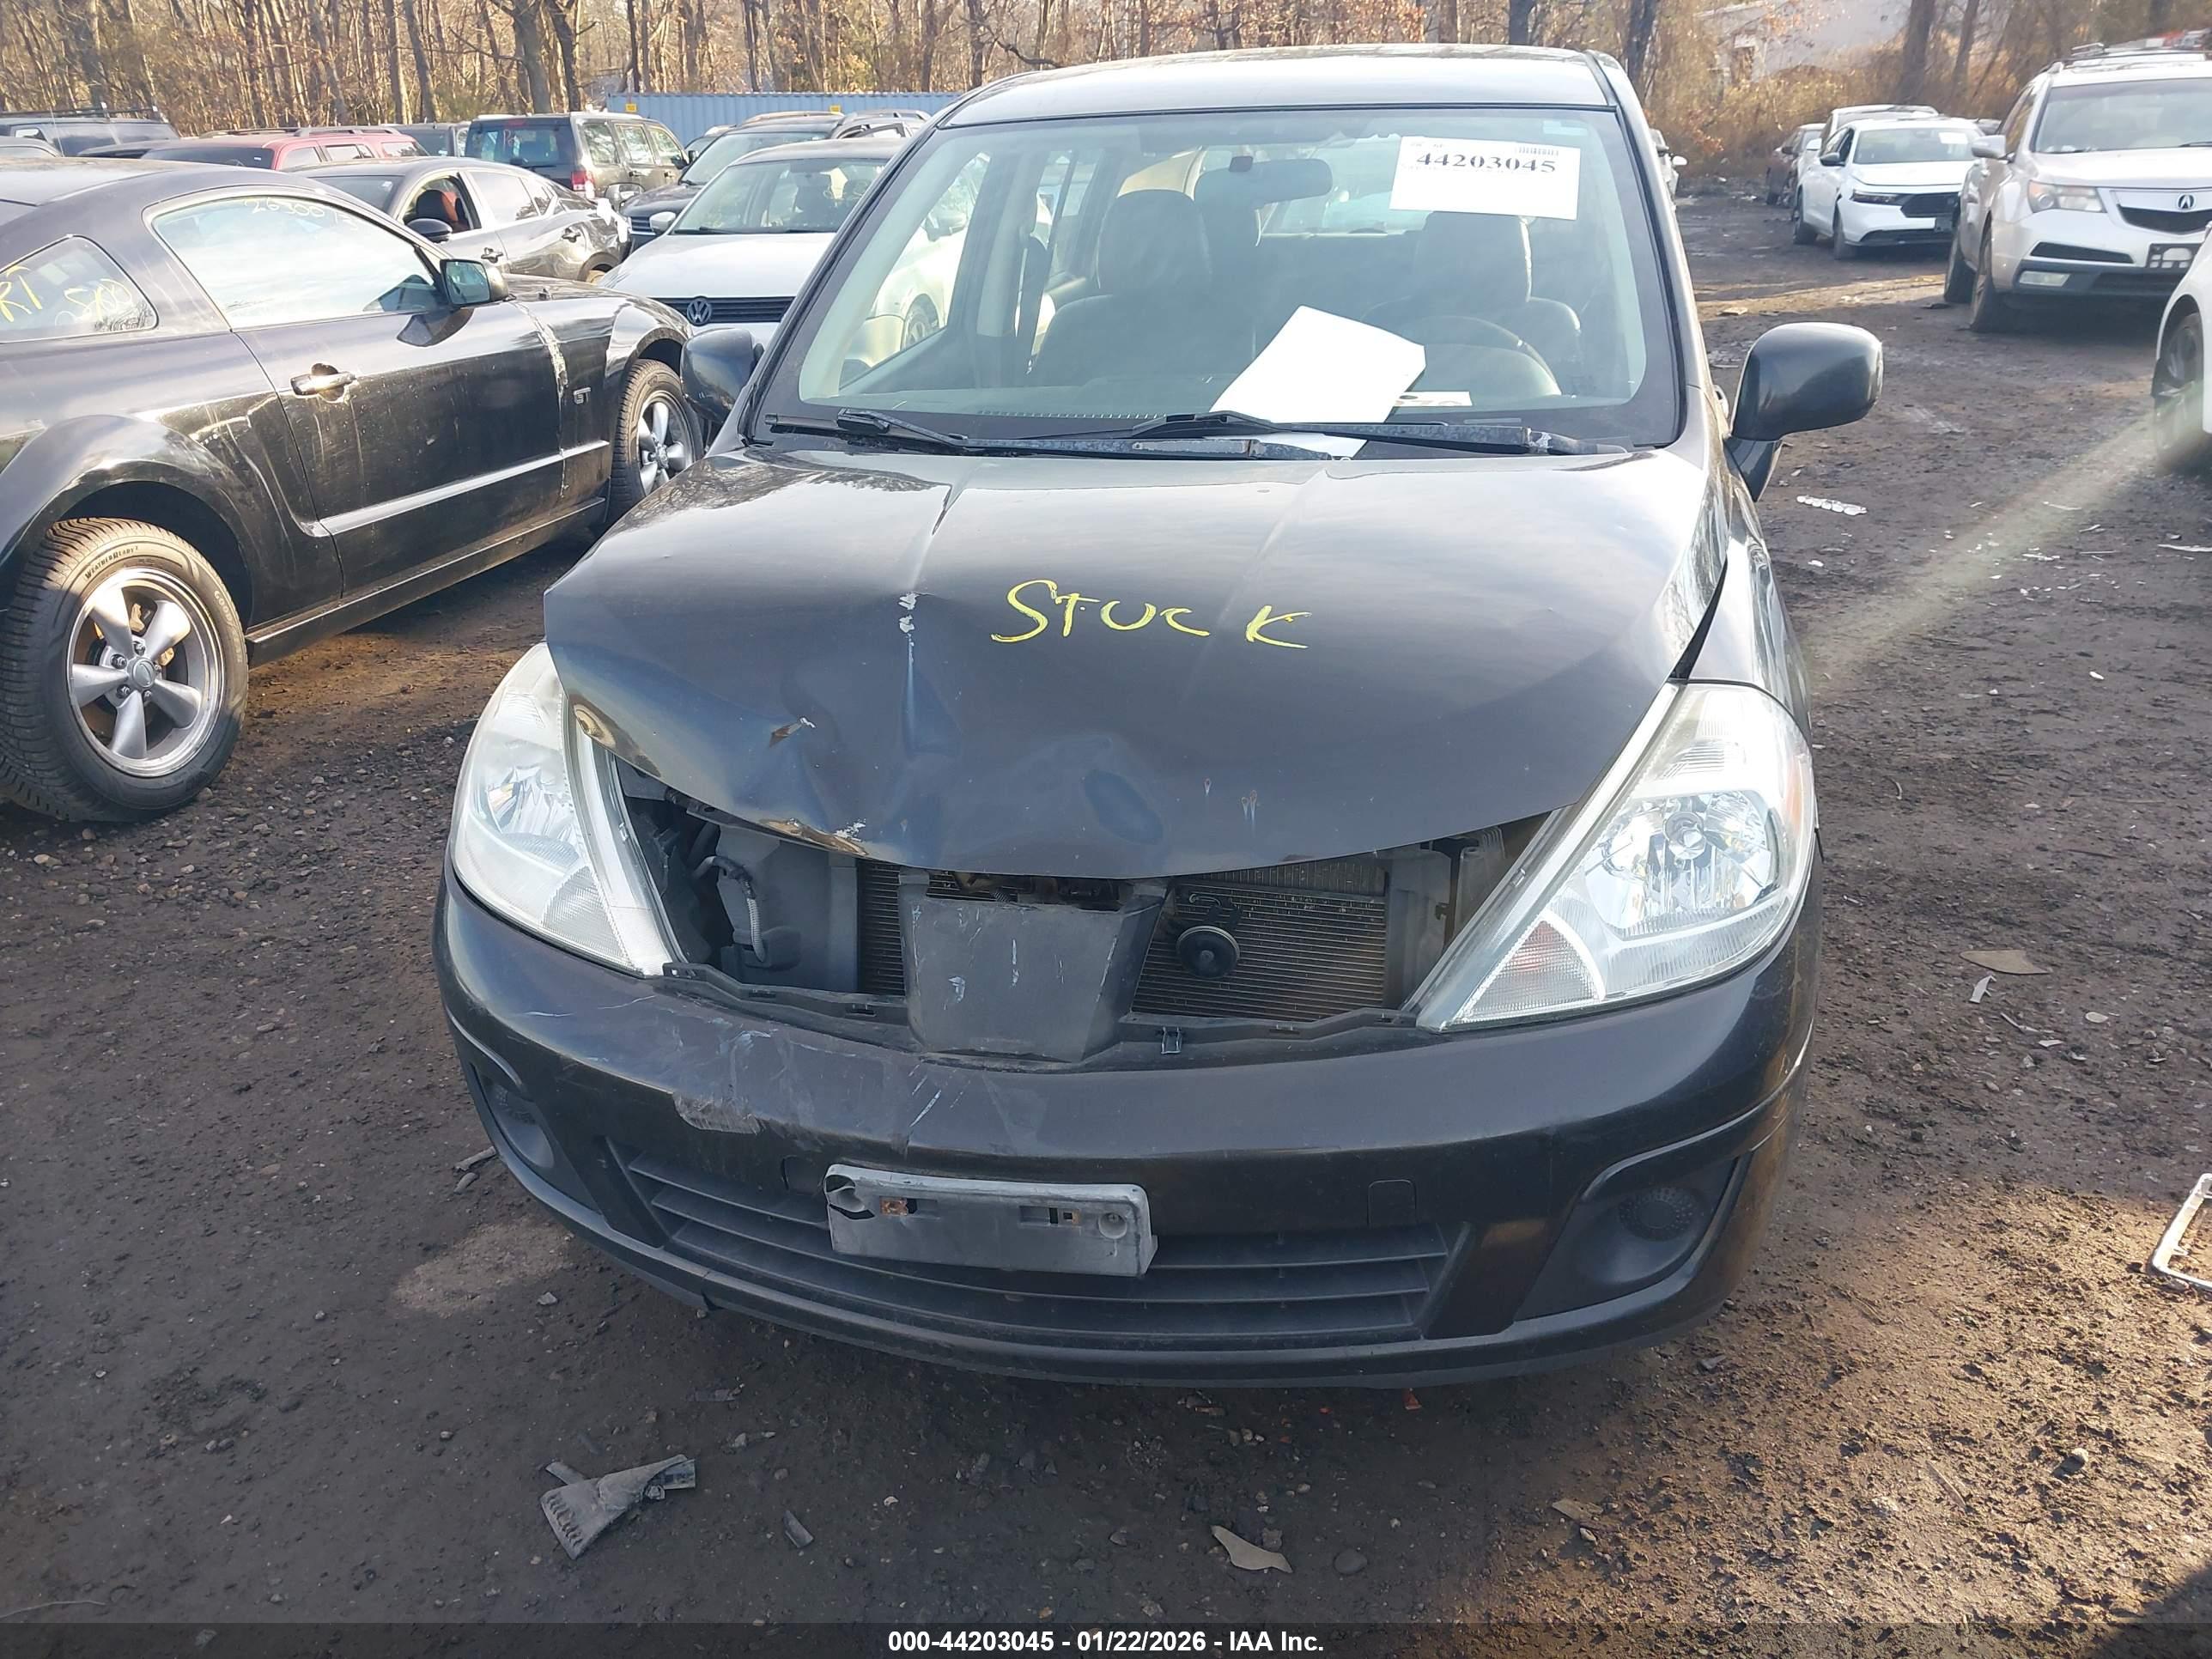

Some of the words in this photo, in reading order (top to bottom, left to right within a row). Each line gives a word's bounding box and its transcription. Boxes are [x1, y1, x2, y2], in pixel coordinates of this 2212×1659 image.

[1417, 152, 1557, 173] 44203045
[574, 386, 592, 404] GT
[990, 579, 1313, 649] STUCK
